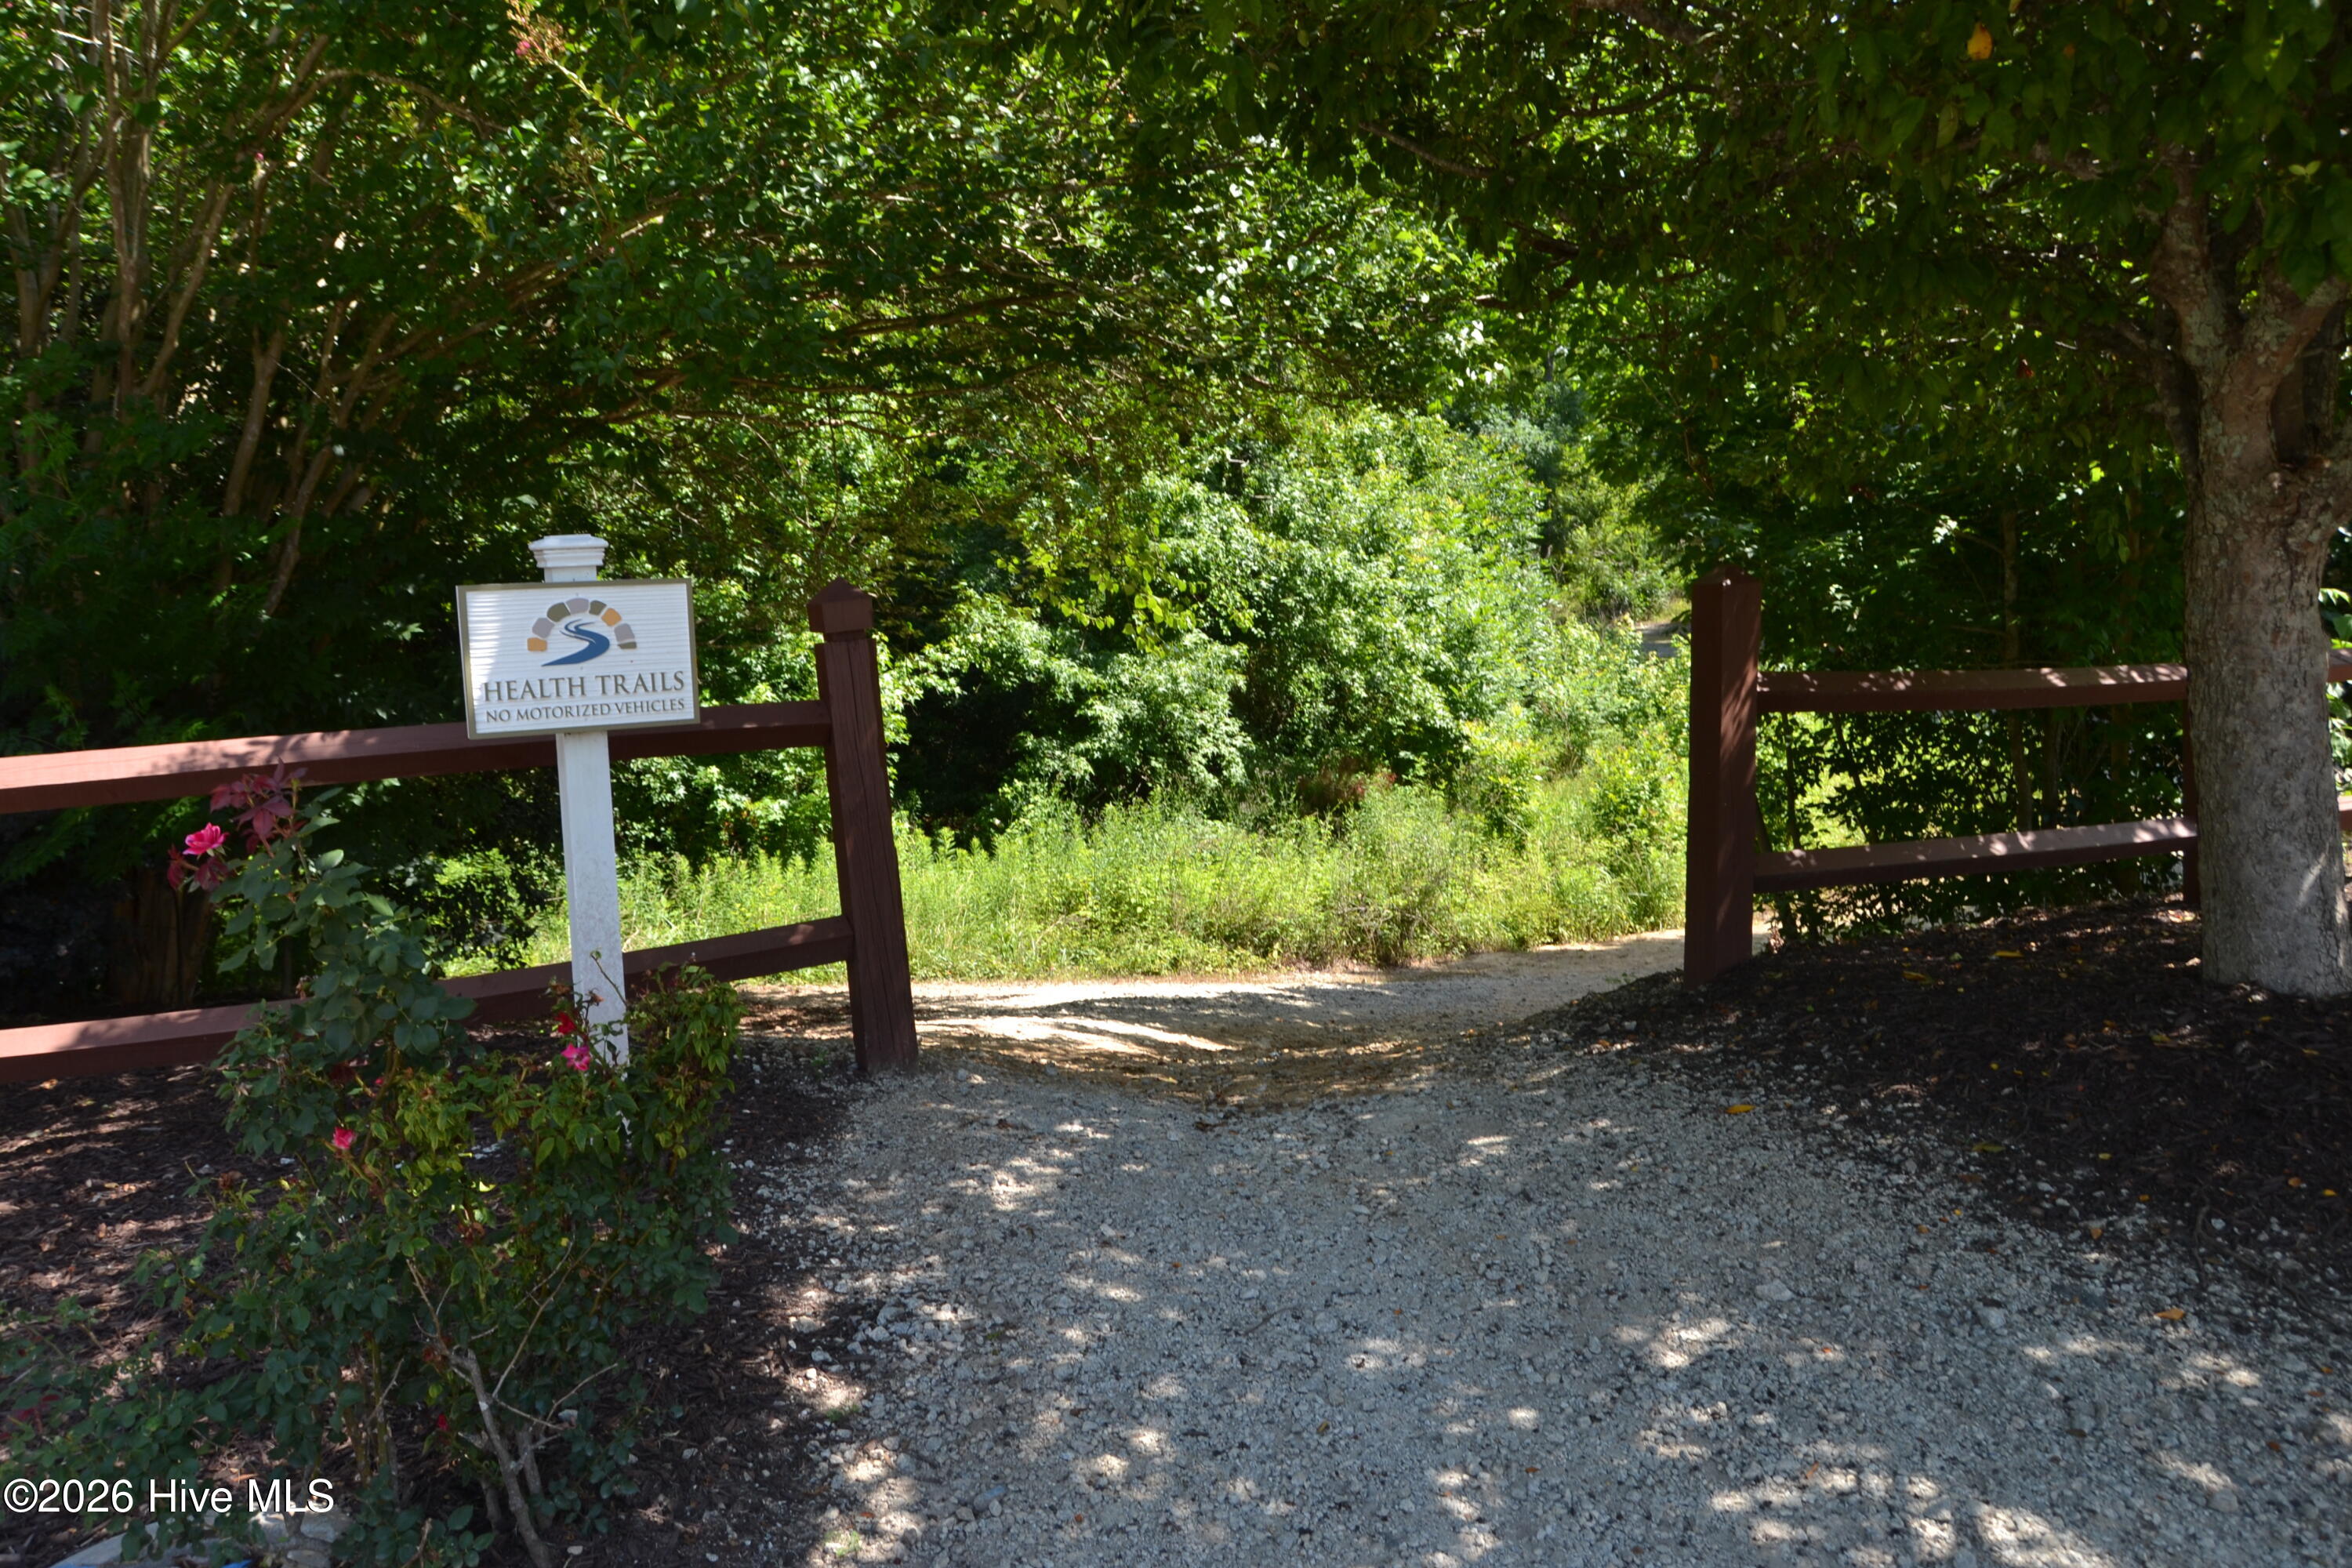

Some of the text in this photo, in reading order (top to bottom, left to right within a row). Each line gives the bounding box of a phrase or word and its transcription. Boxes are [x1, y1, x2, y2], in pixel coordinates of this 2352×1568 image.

[484, 670, 684, 702] HEALTH TRAILS
[485, 699, 684, 723] NO MOTORIZED VEHICLES
